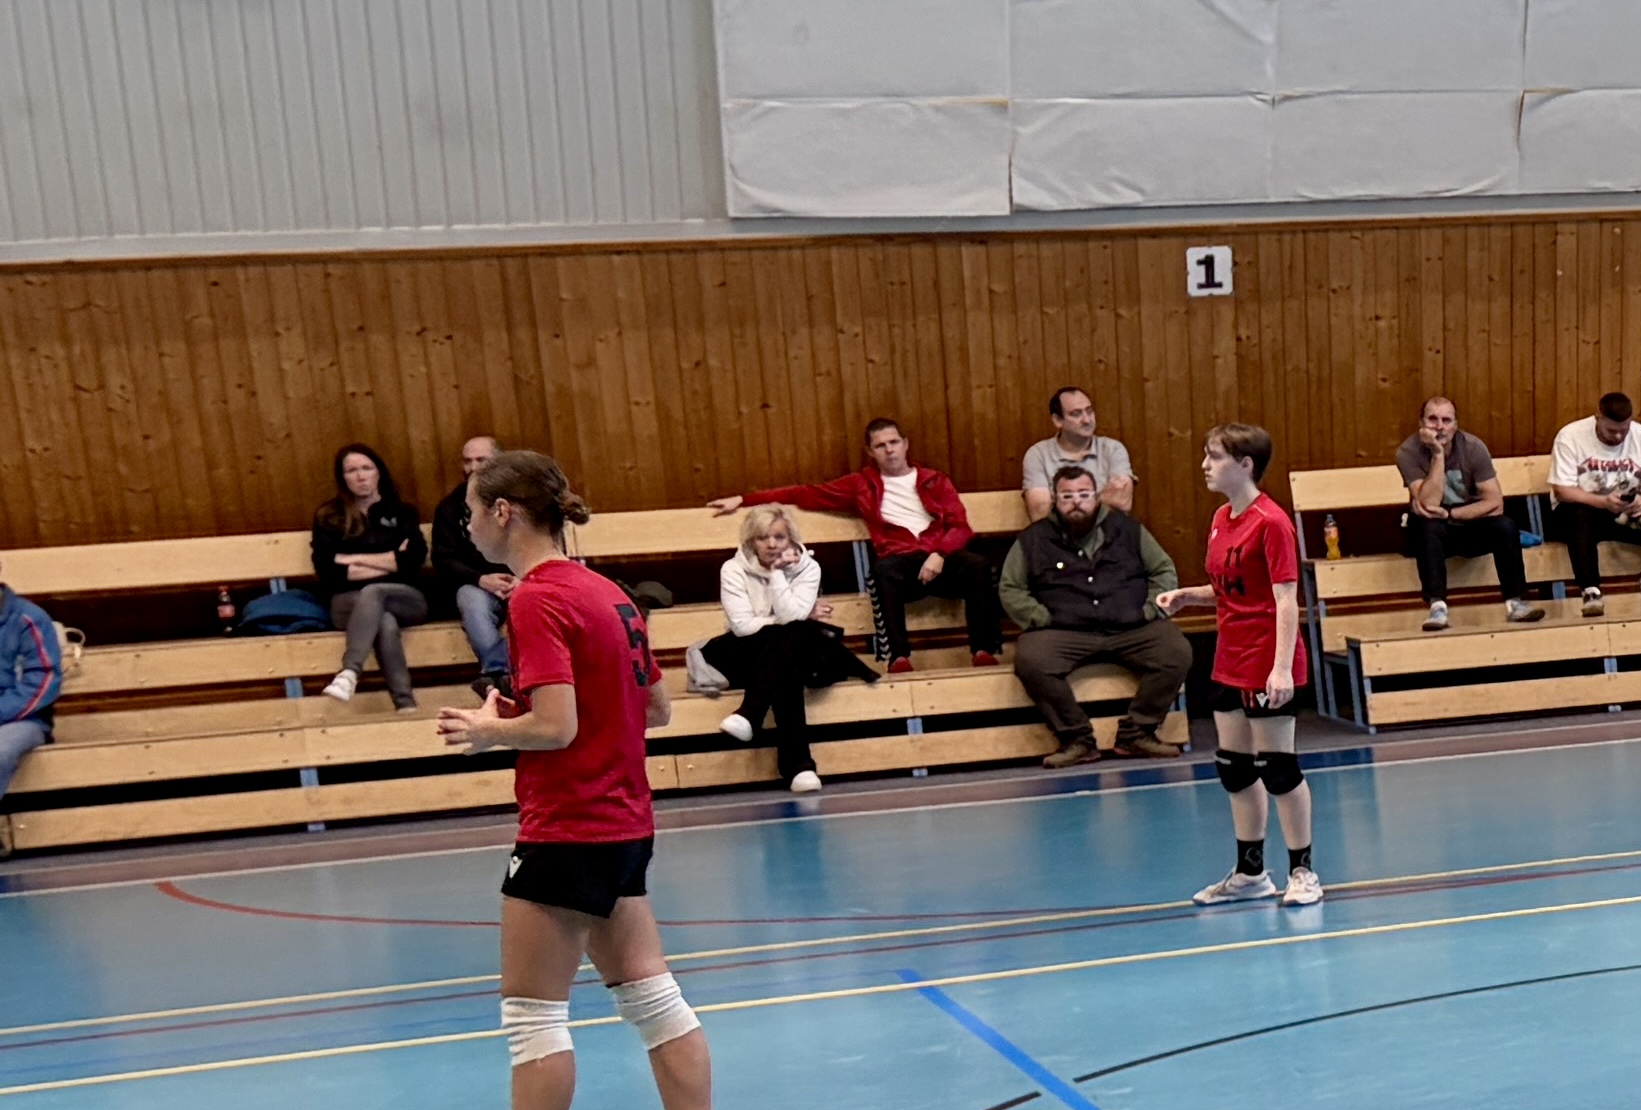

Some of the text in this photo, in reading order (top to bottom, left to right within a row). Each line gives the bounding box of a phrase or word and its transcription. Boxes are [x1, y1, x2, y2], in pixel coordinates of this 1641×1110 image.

[1196, 254, 1223, 289] 1
[1224, 545, 1243, 568] 11
[613, 603, 652, 687] 5
